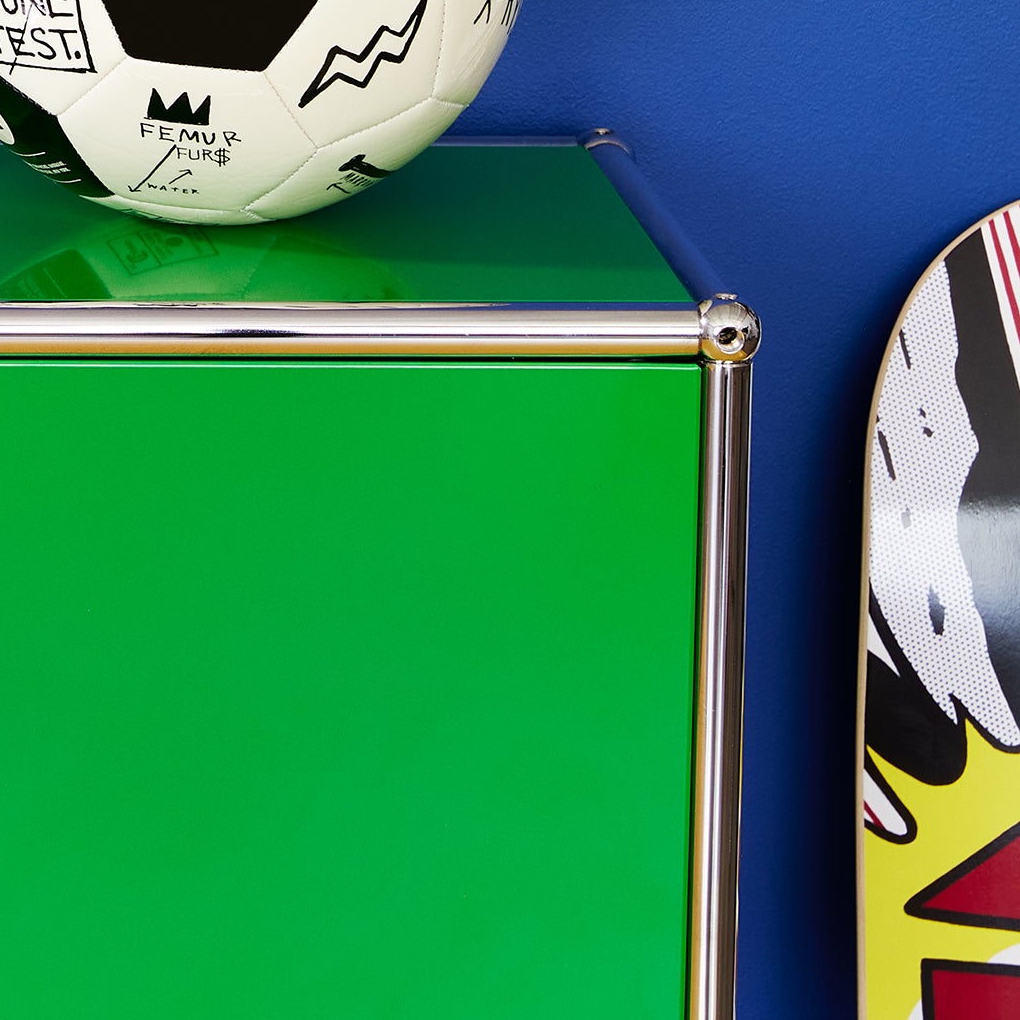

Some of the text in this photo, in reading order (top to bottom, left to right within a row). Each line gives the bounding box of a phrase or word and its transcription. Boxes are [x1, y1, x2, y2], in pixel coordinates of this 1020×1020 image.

[140, 122, 242, 147] FEMUR
[176, 147, 231, 168] FUR$
[147, 182, 200, 195] WATER
